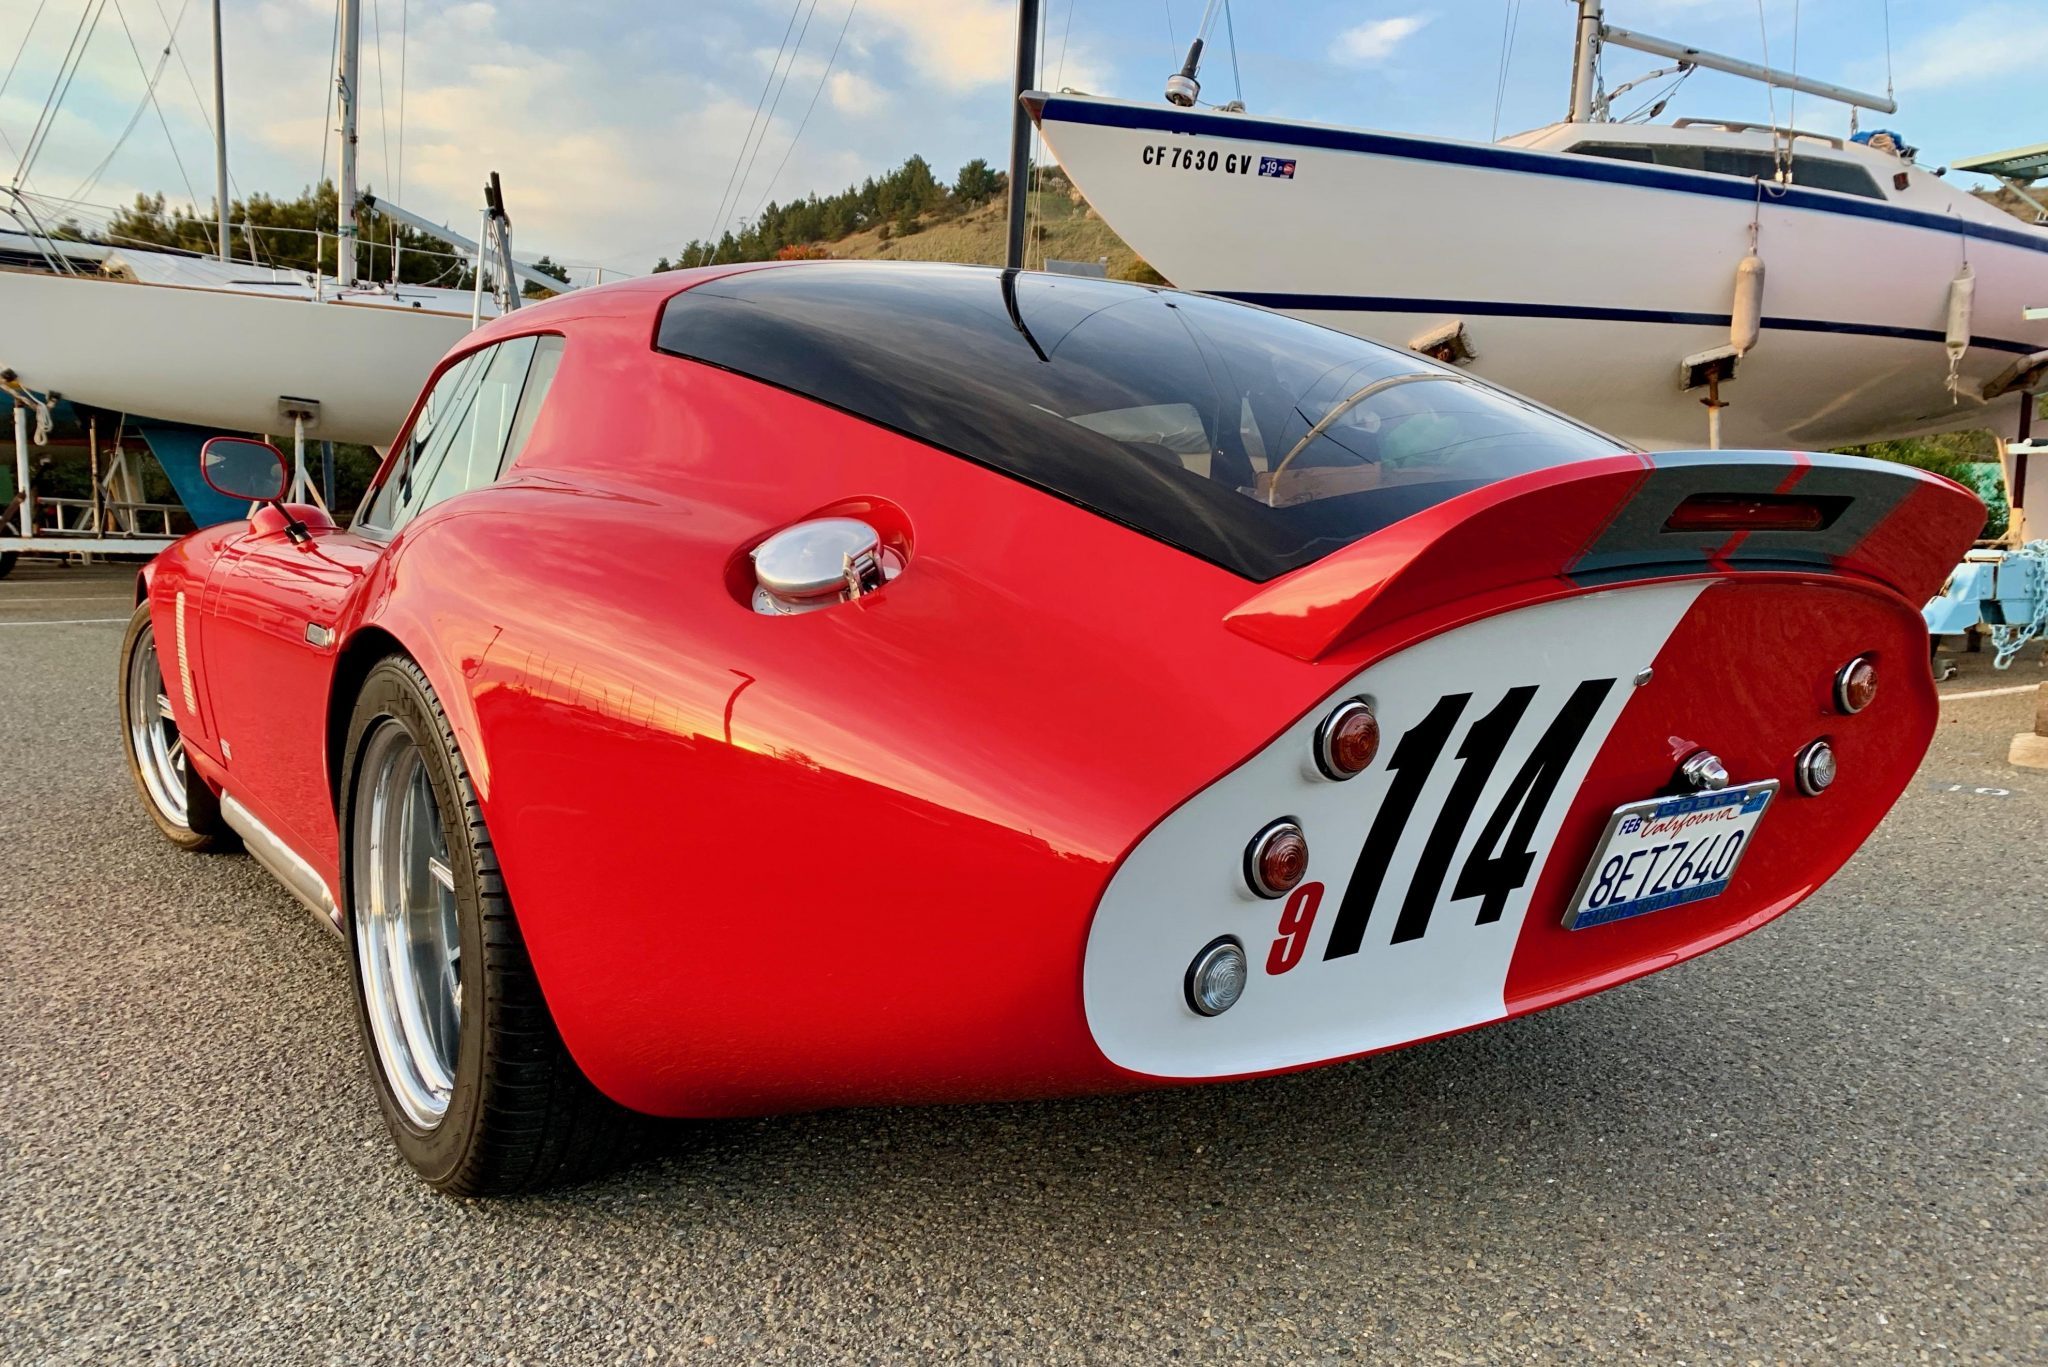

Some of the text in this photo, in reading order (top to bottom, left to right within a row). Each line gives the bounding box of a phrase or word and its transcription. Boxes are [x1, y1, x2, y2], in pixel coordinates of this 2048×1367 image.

[1143, 145, 1252, 175] CF 7630 GV
[1265, 160, 1278, 174] 19
[1661, 793, 1741, 814] COBRA
[1322, 677, 1618, 962] 114
[1618, 817, 1643, 836] FEB
[1641, 807, 1738, 839] California
[1587, 829, 1745, 909] 8ETZ640
[1265, 881, 1325, 976] 9
